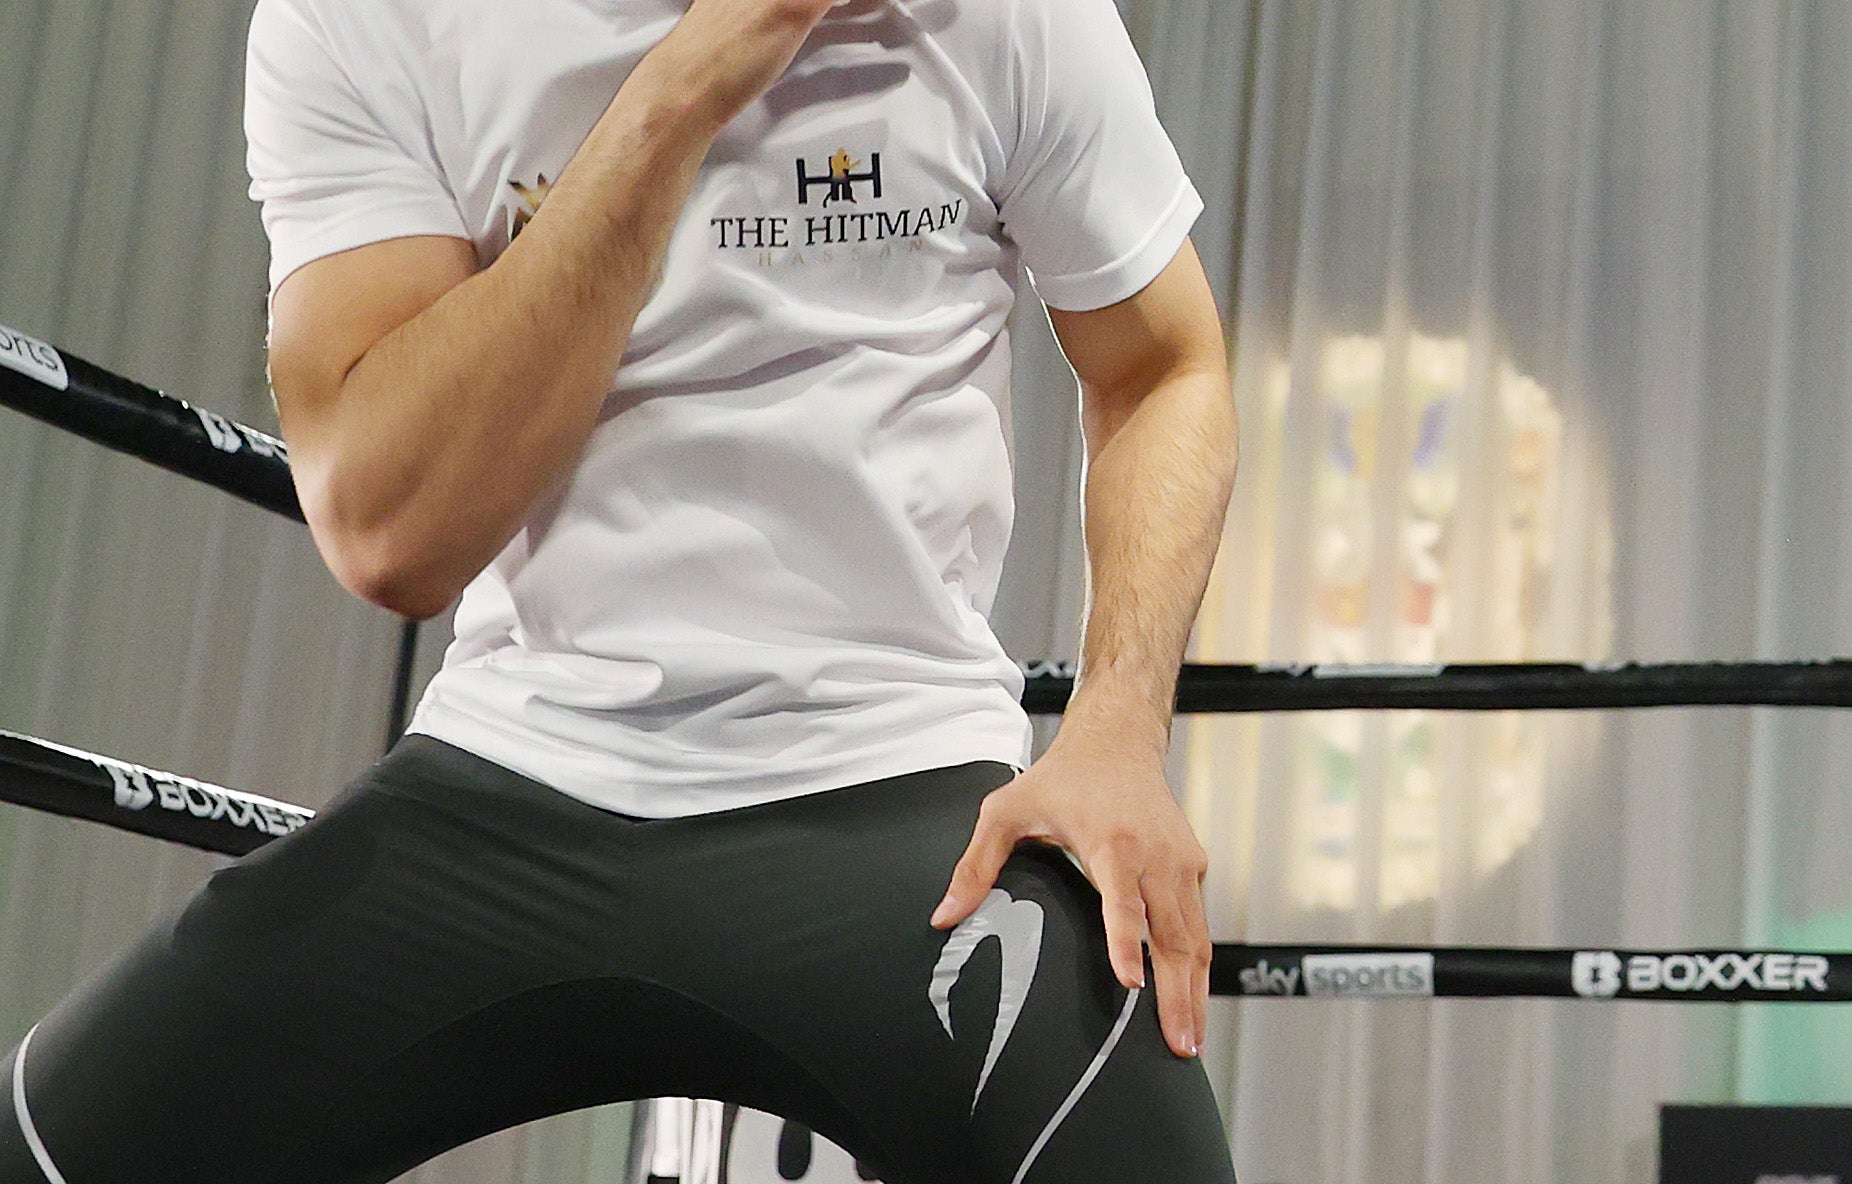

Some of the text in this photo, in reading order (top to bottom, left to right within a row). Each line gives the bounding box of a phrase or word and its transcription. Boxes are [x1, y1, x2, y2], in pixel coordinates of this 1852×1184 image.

[711, 199, 962, 248] THE HITMAN
[757, 240, 924, 267] HASSAN
[1239, 959, 1428, 996] sky sports
[1627, 953, 1829, 992] BOXXER
